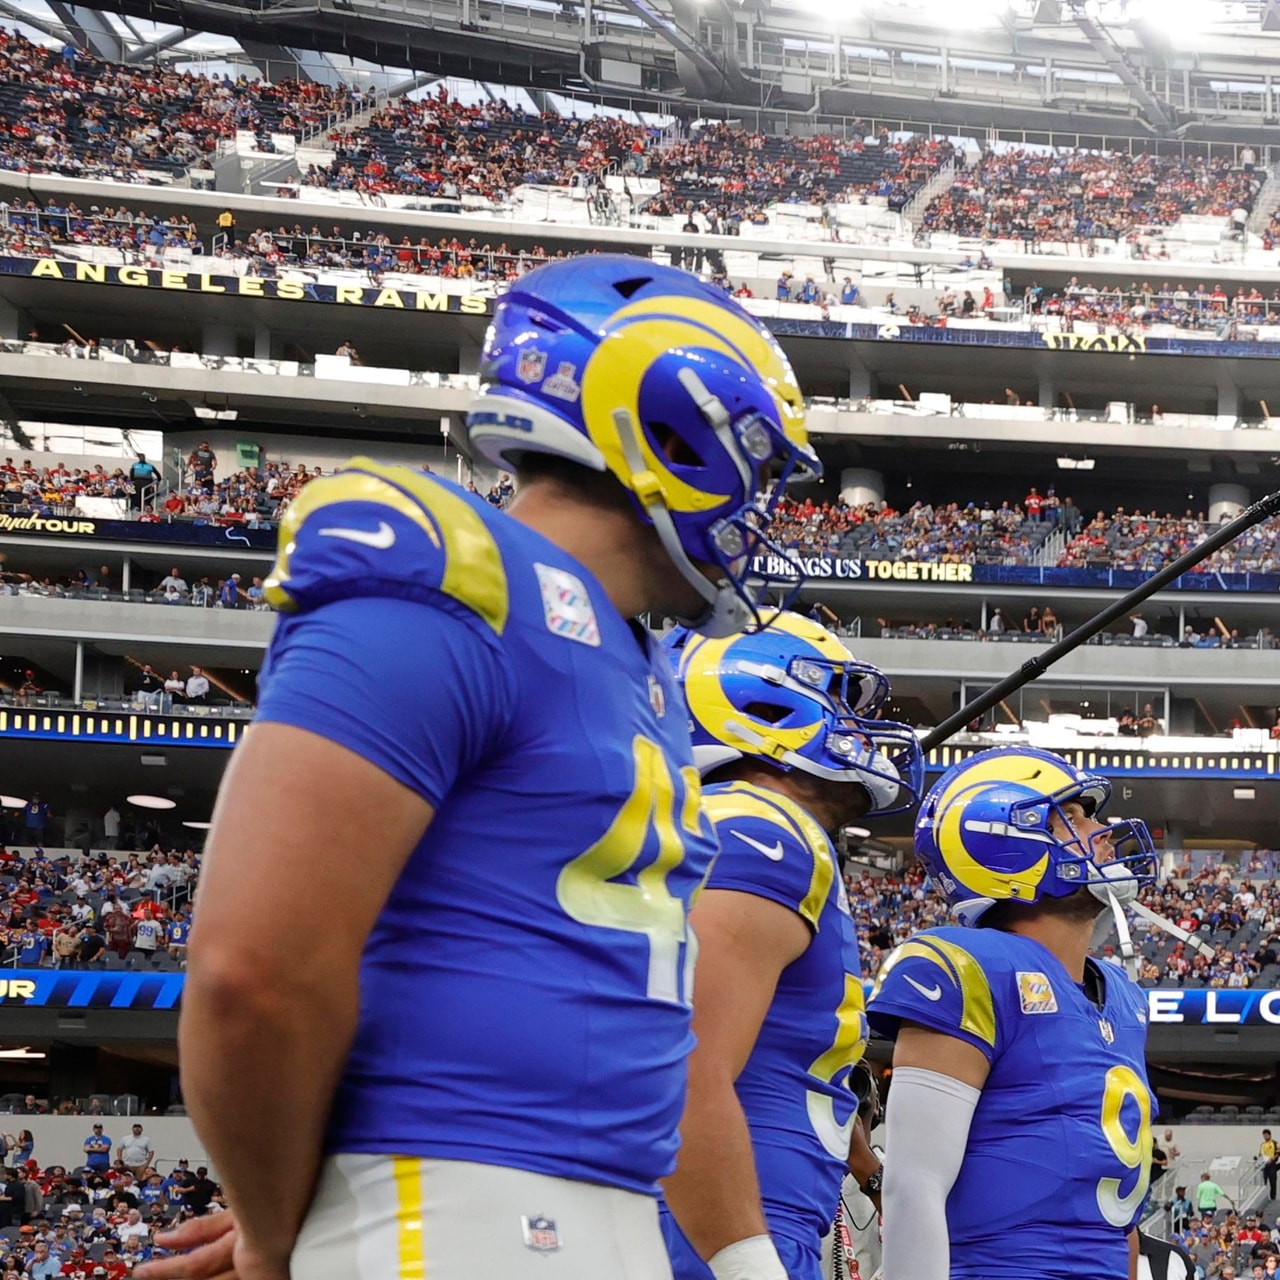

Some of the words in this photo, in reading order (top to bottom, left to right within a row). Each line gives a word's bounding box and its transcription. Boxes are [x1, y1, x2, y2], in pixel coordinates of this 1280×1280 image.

[31, 258, 304, 300] ANGELES
[335, 286, 488, 315] RAMS
[35, 518, 95, 534] TOUR
[835, 559, 862, 578] US
[865, 560, 973, 582] TOGETHER
[138, 924, 154, 937] 99
[1096, 1064, 1152, 1228] 9
